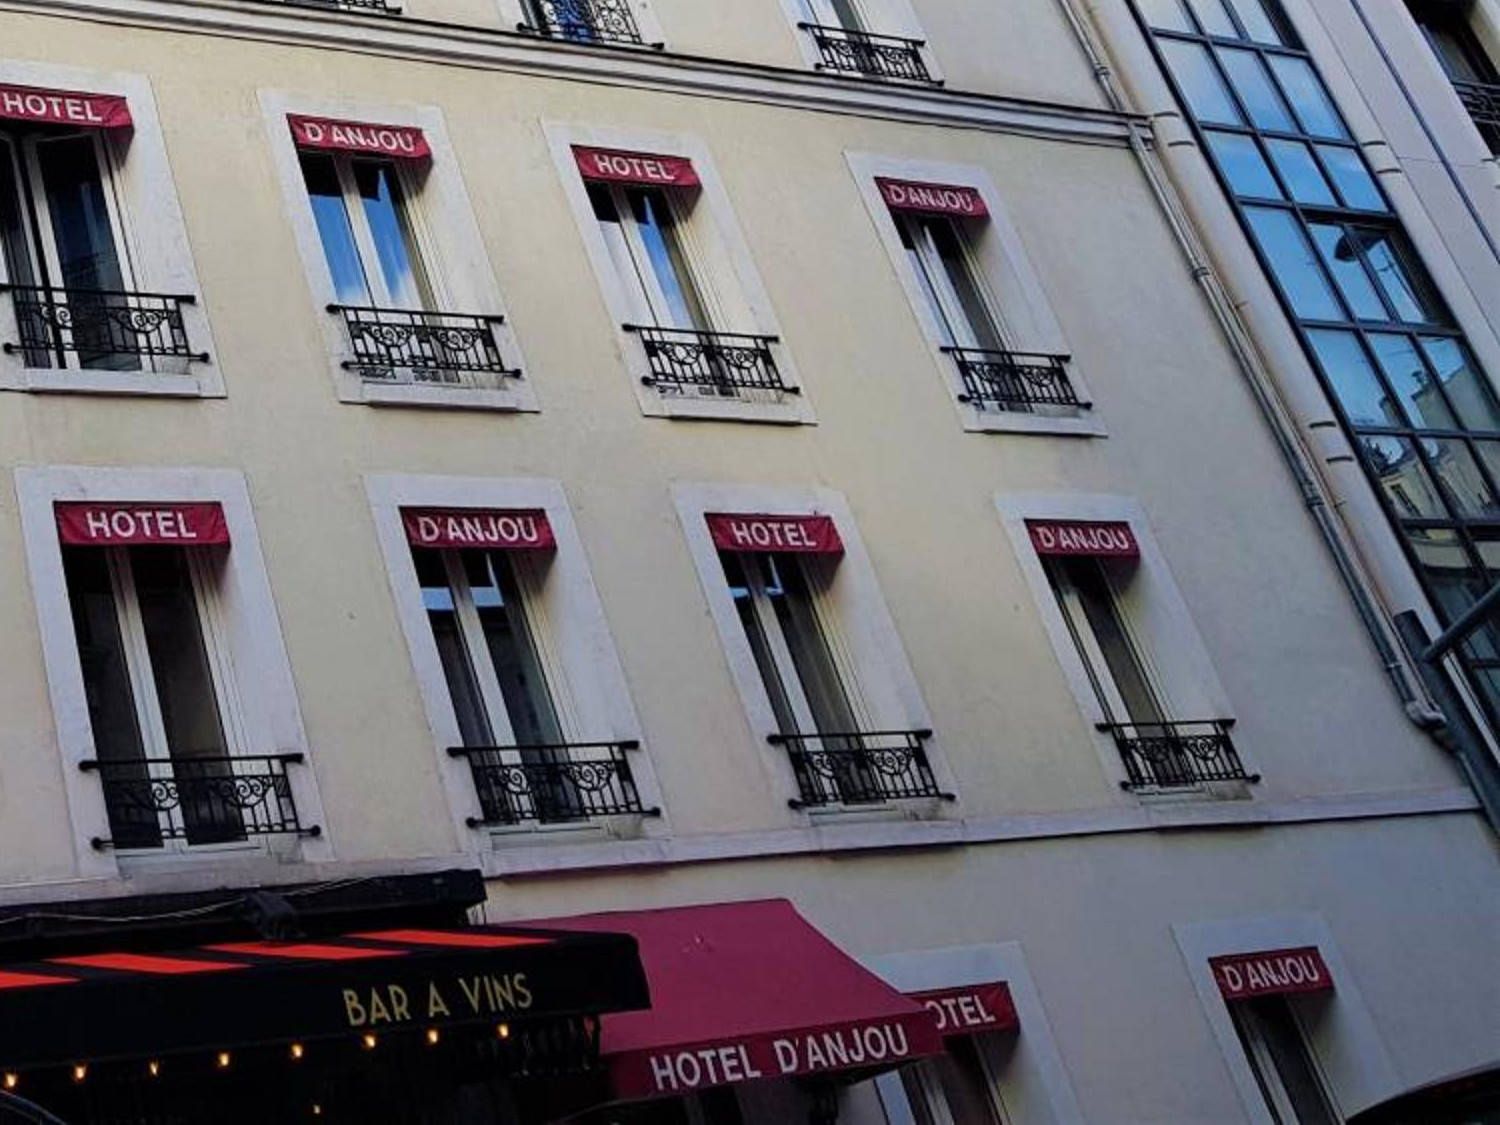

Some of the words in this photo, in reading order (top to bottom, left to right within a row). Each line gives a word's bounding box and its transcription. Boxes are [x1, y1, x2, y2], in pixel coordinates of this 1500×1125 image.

[3, 93, 102, 121] HOTEL
[304, 123, 414, 151] D'ANJOU
[594, 155, 675, 180] HOTEL
[887, 185, 973, 211] D'ANJOU
[86, 511, 196, 537] HOTEL
[418, 517, 538, 541] D'ANJOU
[731, 522, 816, 546] HOTEL
[1036, 527, 1129, 549] D'ANJOU
[1224, 955, 1320, 990] D'ANJOU
[343, 984, 411, 1026] BAR
[428, 981, 450, 1018] A
[458, 972, 533, 1014] VINS
[925, 994, 996, 1029] OTEL
[650, 1044, 762, 1091] HOTEL
[773, 1023, 909, 1074] D'ANJOU
